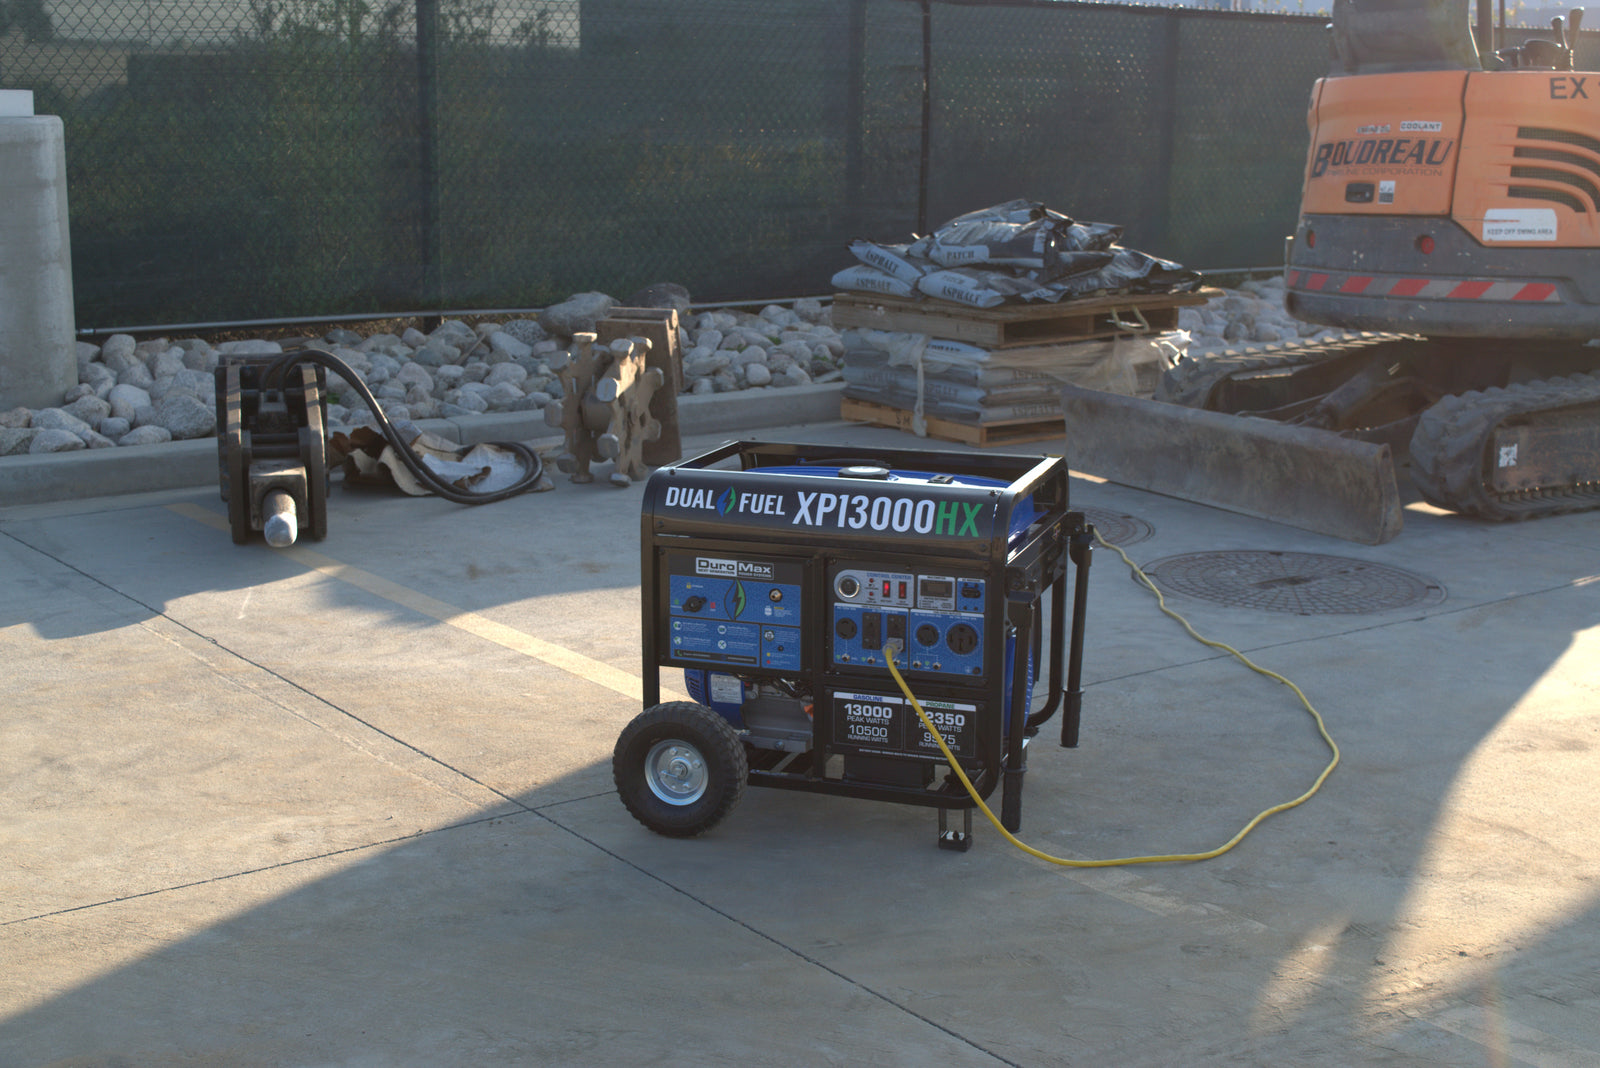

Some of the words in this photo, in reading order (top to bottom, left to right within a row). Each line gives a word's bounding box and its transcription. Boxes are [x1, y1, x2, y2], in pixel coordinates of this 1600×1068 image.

[1549, 76, 1589, 100] EX
[1401, 122, 1441, 130] COOLANT
[1311, 139, 1453, 178] BOUDREAU
[1362, 167, 1443, 177] CORPORATION
[865, 249, 899, 274] ASPHALT
[946, 250, 975, 260] PATCH
[855, 277, 892, 290] ASPHALT
[942, 285, 982, 305] ASPHALT
[665, 486, 716, 510] DUAL
[738, 492, 786, 516] FUEL
[792, 491, 984, 538] XP13000HX
[853, 694, 883, 702] GASOLINE
[843, 703, 893, 719] 13000
[925, 701, 955, 709] PROPANE
[846, 715, 865, 723] PEAK
[866, 717, 890, 726] WATTS
[916, 711, 965, 727] 2350
[848, 724, 888, 738] 10500
[938, 724, 962, 733] WATTS
[847, 734, 870, 742] RUNNING
[870, 735, 889, 743] WATTS
